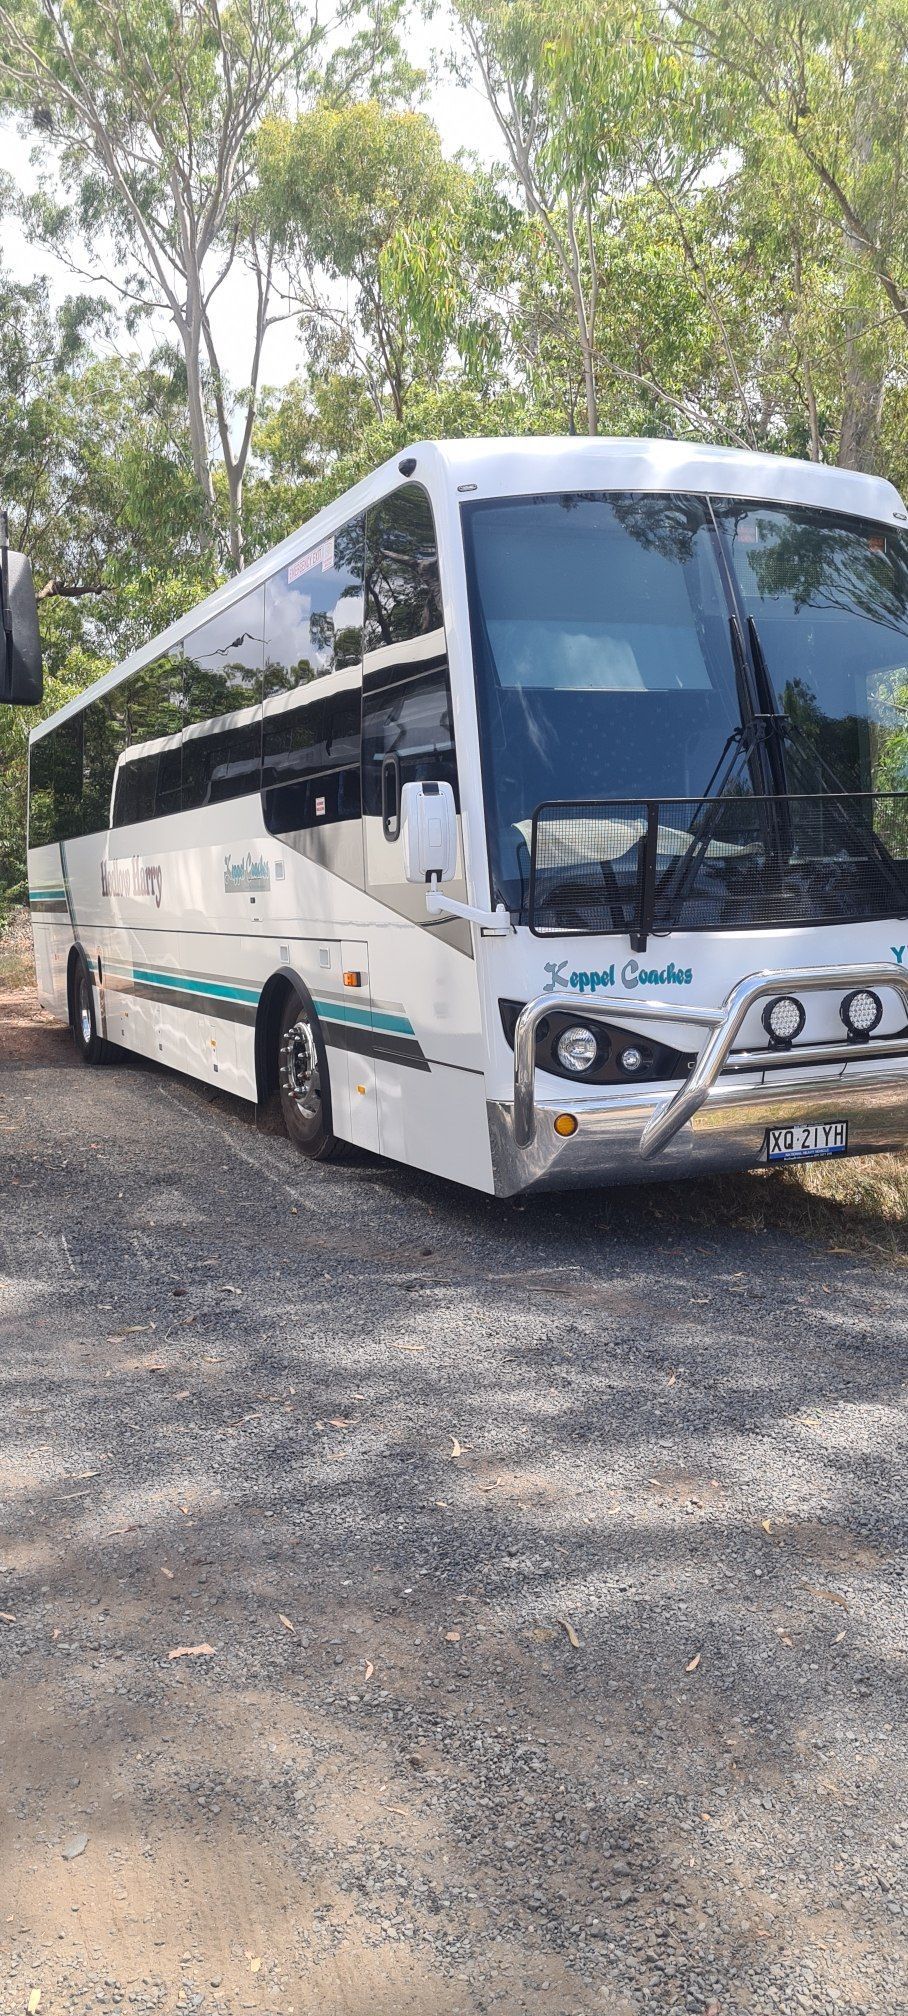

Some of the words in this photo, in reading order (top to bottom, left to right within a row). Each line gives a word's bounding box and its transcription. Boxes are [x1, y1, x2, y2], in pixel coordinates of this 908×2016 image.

[289, 552, 311, 581] EMERGENCY
[312, 546, 322, 565] EXIT
[132, 855, 162, 909] Harry
[543, 960, 615, 992] Keppel
[621, 959, 693, 989] Coaches
